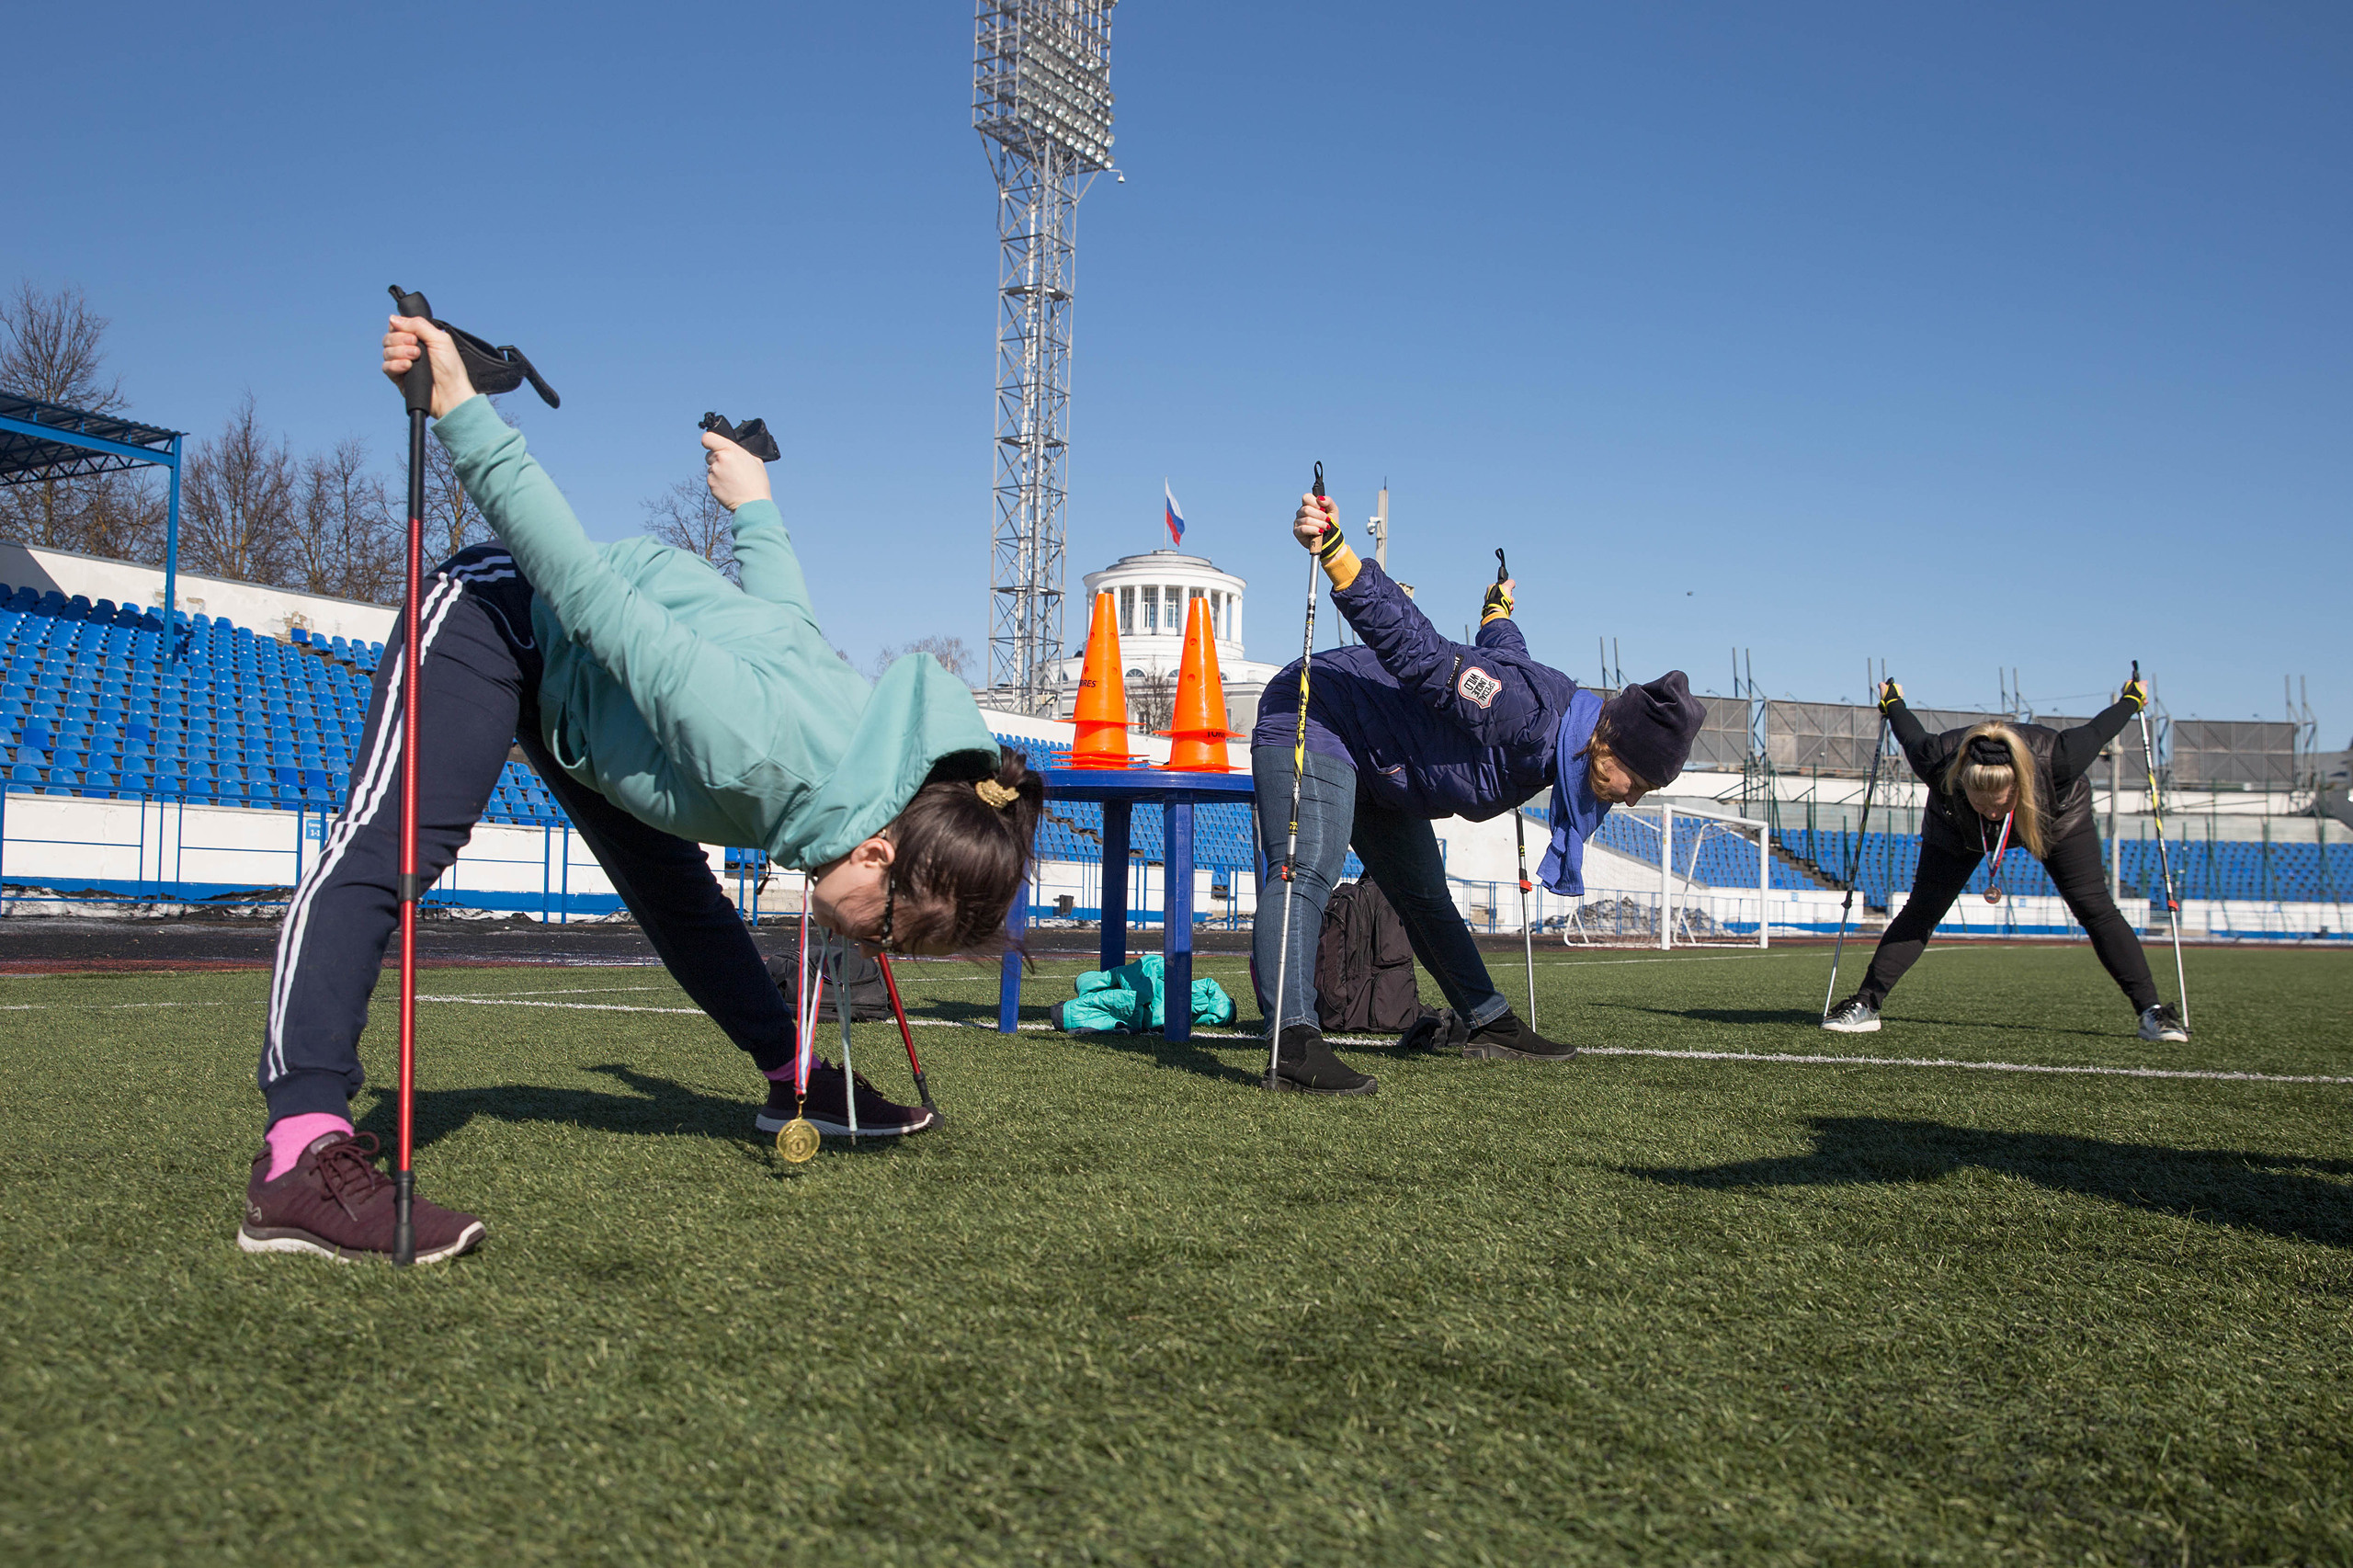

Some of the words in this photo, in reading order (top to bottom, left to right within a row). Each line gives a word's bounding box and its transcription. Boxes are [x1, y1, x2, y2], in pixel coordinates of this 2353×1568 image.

[1463, 673, 1480, 690] WILD
[1478, 681, 1495, 701] SPECIAL
[1298, 699, 1307, 740] FINPOLE
